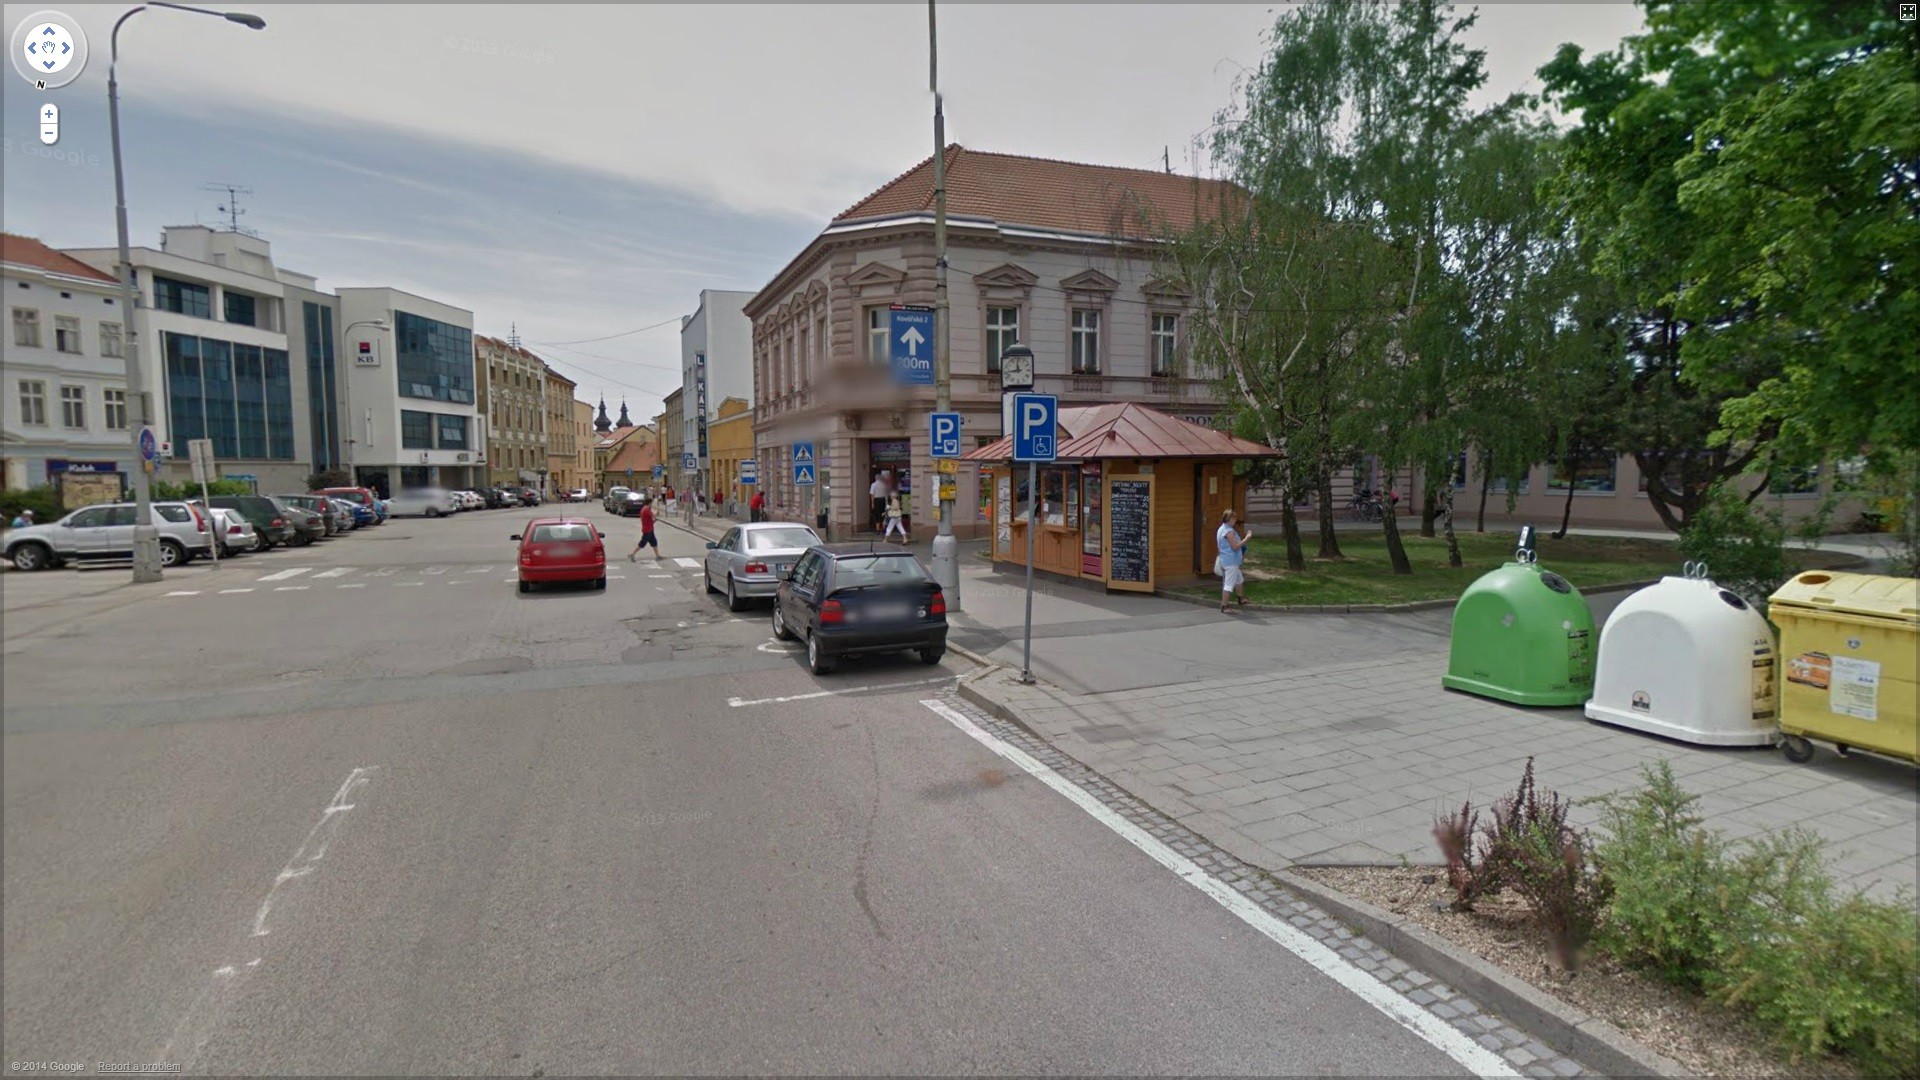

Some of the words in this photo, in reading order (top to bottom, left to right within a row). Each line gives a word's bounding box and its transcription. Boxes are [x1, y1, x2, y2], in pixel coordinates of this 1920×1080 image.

[357, 355, 374, 363] KB
[936, 418, 954, 444] P
[1023, 403, 1048, 440] P
